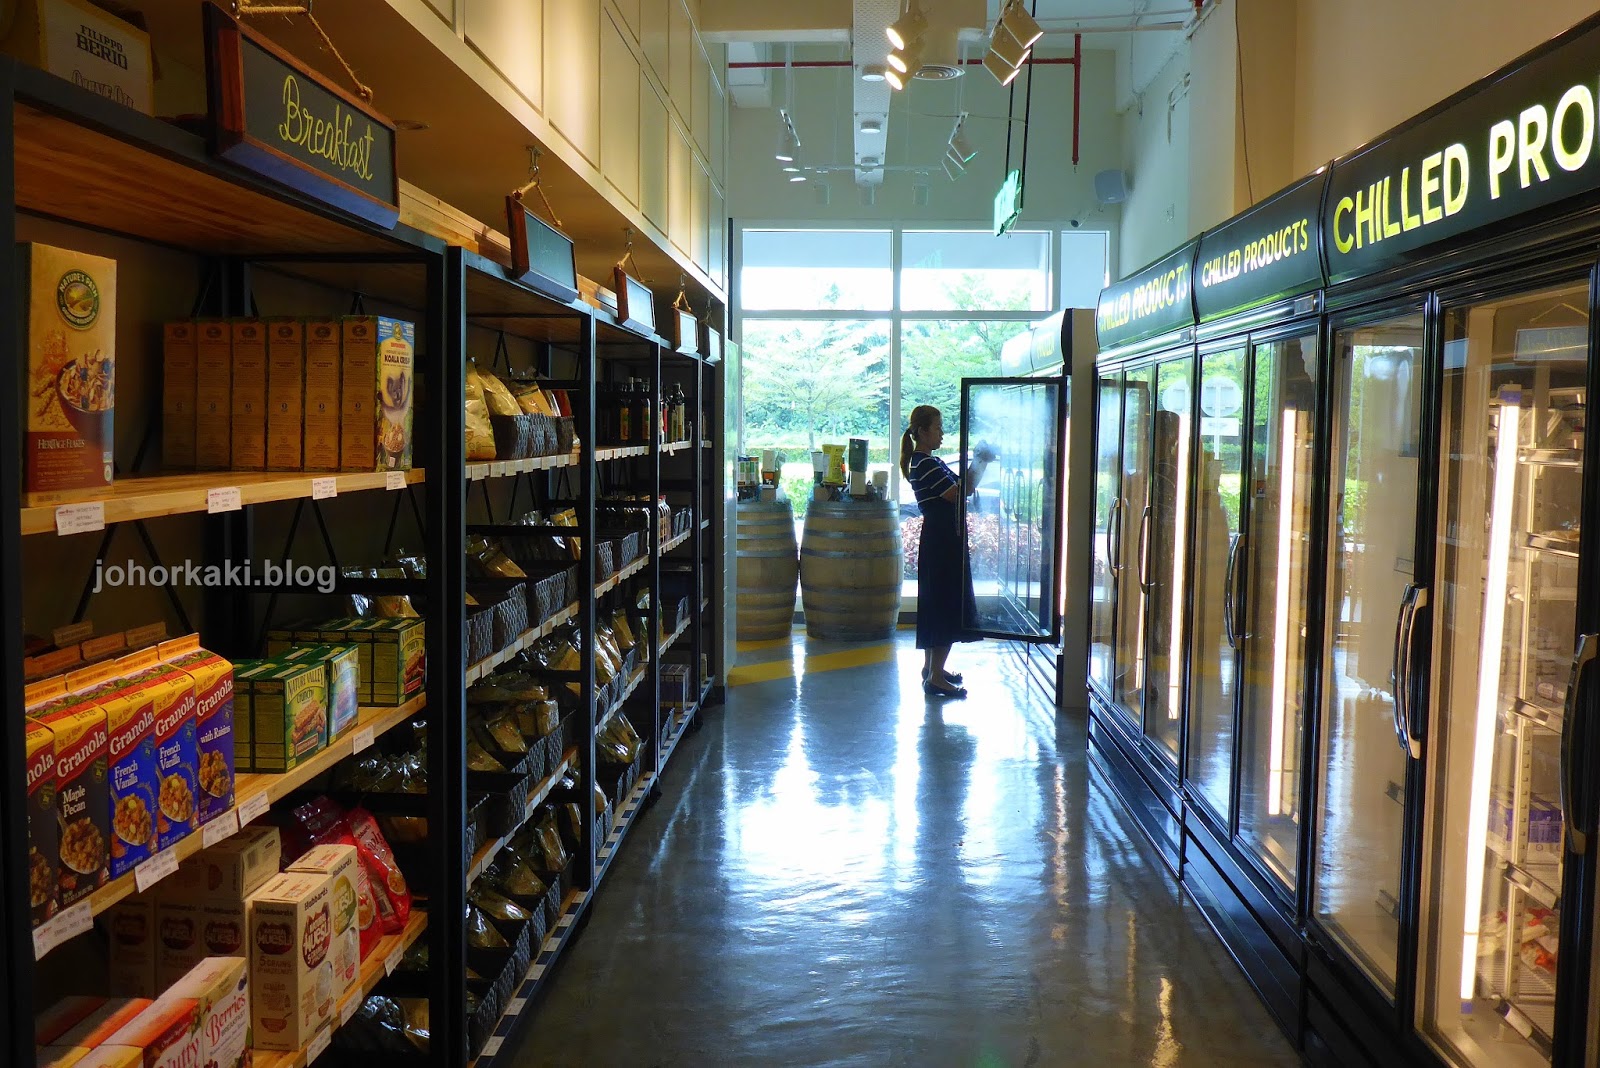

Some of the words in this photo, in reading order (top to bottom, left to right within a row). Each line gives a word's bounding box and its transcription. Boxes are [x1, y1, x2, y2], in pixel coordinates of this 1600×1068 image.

[75, 33, 128, 70] BERIO
[80, 24, 123, 52] FILIPPO
[279, 75, 374, 181] Breakfast
[1333, 143, 1470, 255] CHILLED
[1488, 84, 1600, 201] PRO
[1201, 247, 1241, 288] CHILLED
[1243, 218, 1309, 274] PRODUCTS
[1132, 262, 1189, 321] PRODUCTS
[196, 679, 234, 717] Granola
[287, 672, 306, 701] NATURE
[306, 665, 325, 688] VALLEY
[155, 695, 195, 737] Granola
[109, 711, 155, 755] Granola
[200, 729, 214, 744] with
[213, 725, 231, 740] Raisins
[57, 731, 107, 778] Granola
[160, 741, 181, 760] French
[160, 753, 181, 770] Vanilla
[26, 754, 55, 786] nola
[114, 759, 138, 779] French
[114, 773, 138, 791] Vanilla
[63, 785, 86, 804] Maple
[63, 801, 86, 818] Pecan
[304, 887, 328, 911] Hubbards
[256, 931, 294, 945] MUESLI
[259, 955, 266, 967] 5
[206, 993, 246, 1048] Berries
[221, 1009, 246, 1037] BREAKFAST
